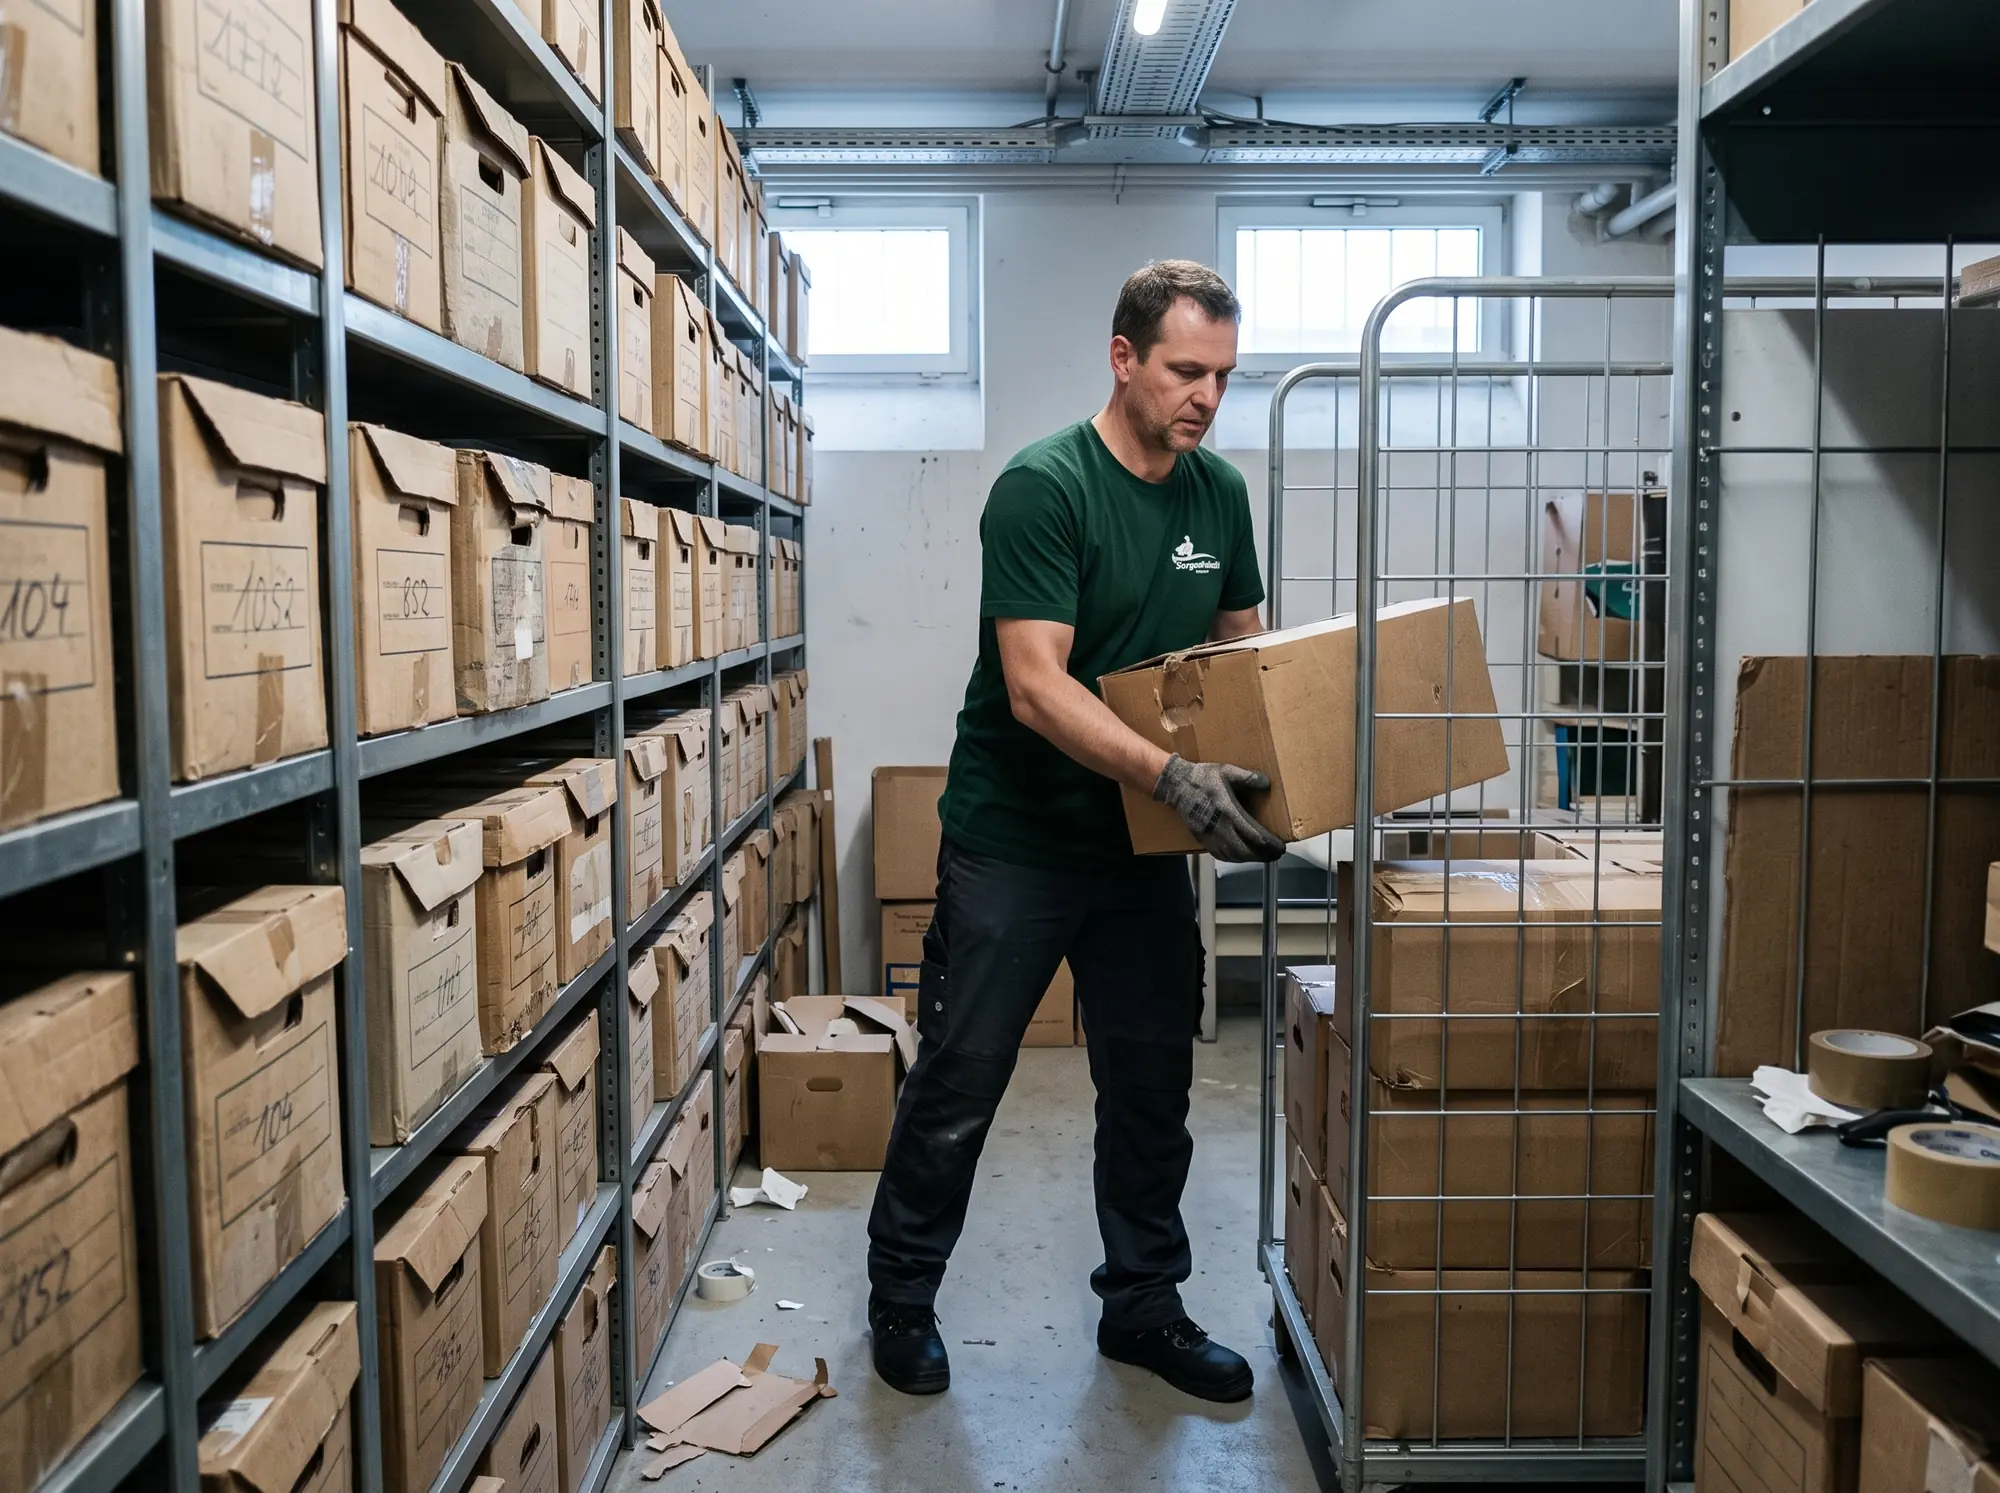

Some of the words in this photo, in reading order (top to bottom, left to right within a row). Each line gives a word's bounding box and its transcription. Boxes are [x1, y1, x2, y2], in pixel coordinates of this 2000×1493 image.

[0, 572, 69, 640] 104
[403, 576, 430, 618] 852
[253, 1091, 293, 1156] 104
